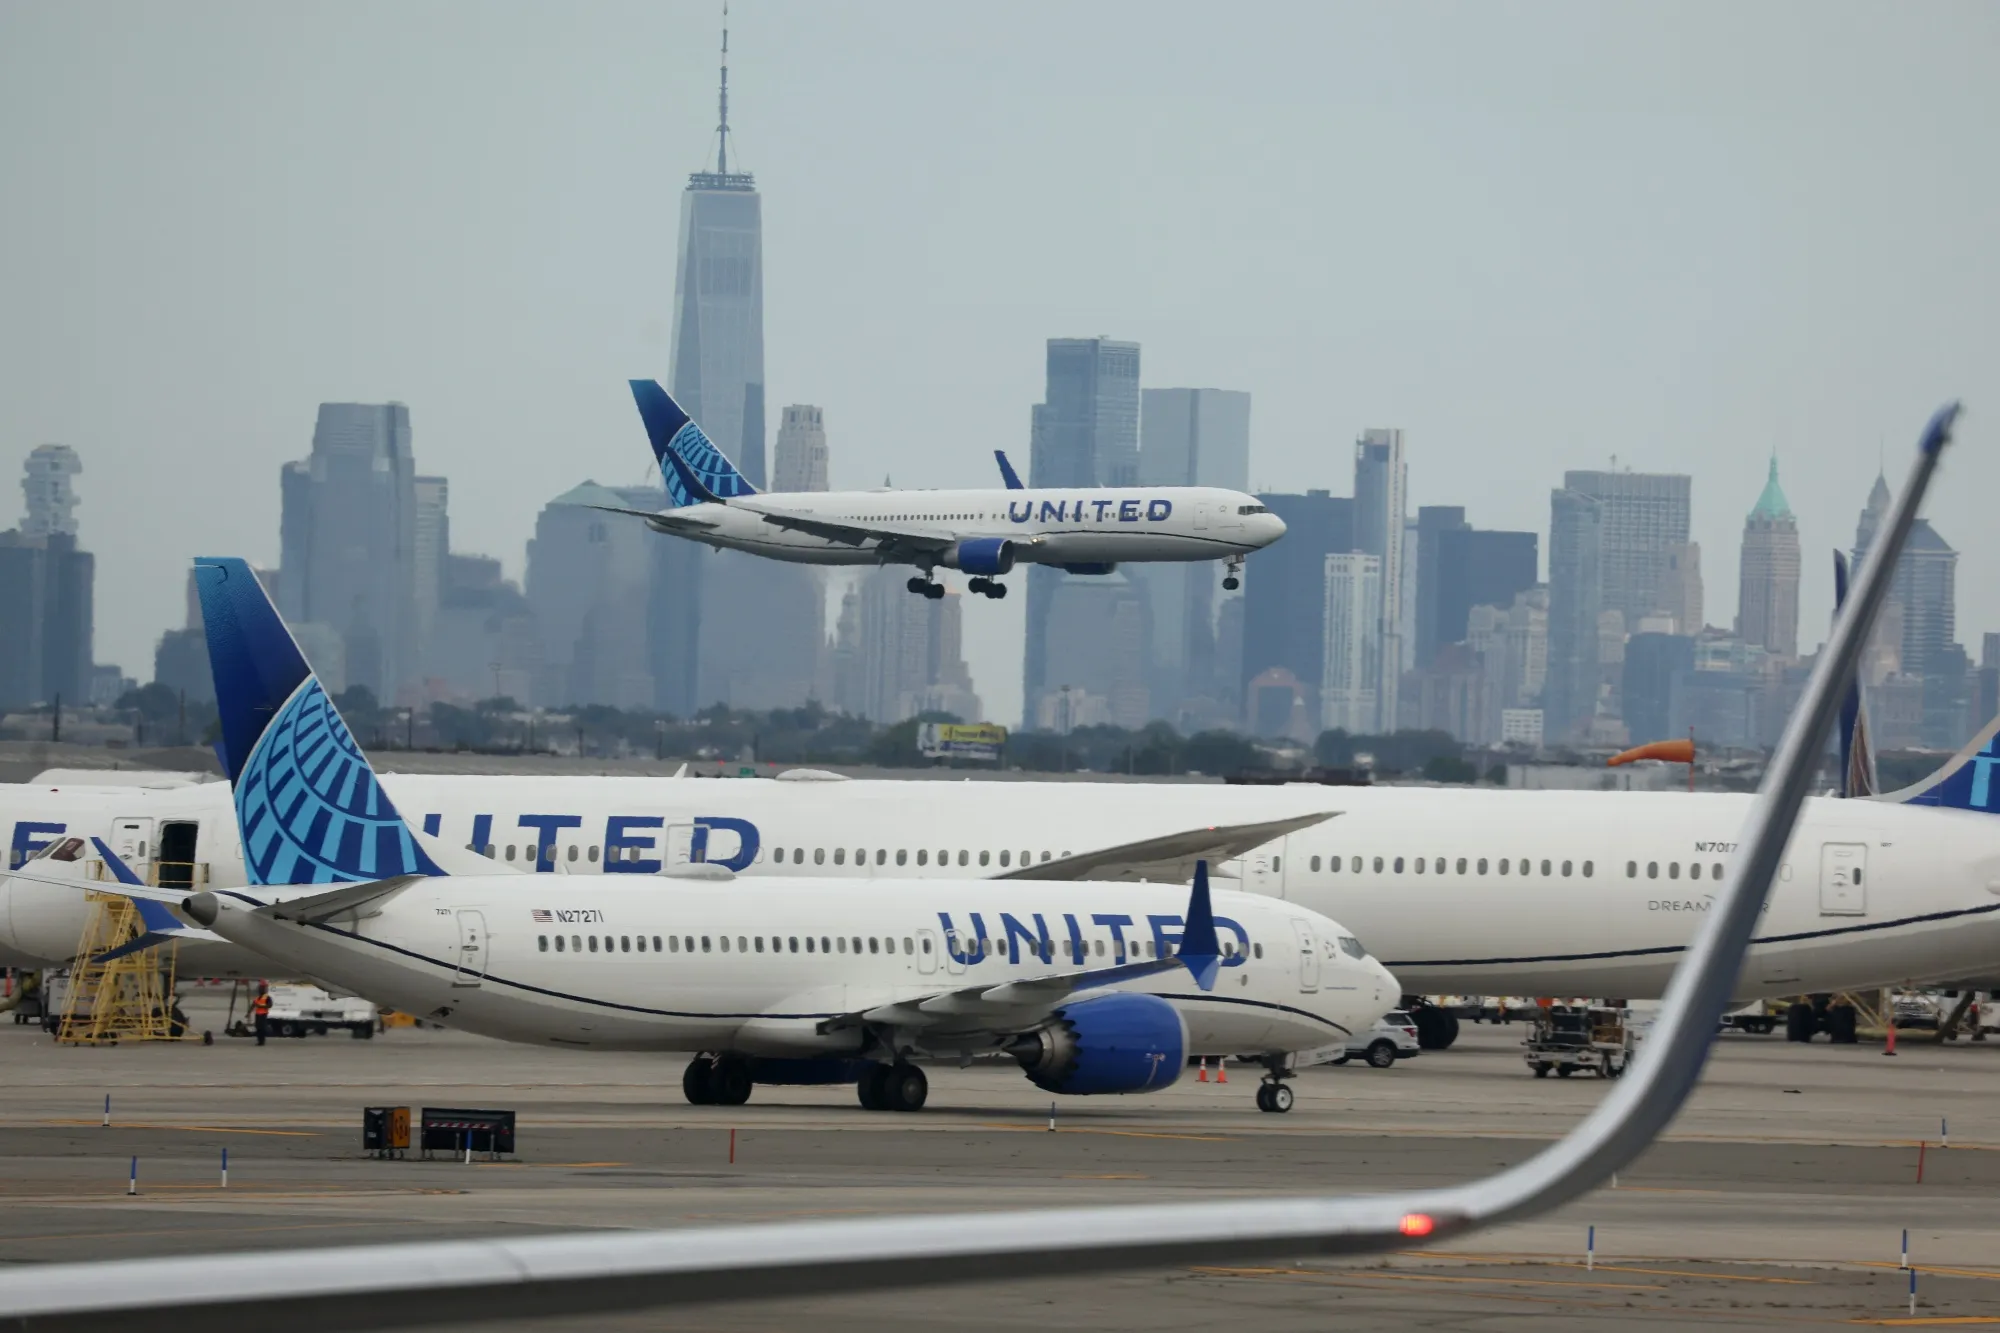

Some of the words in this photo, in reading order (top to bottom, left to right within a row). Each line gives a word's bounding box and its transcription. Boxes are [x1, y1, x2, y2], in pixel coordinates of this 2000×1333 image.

[1009, 500, 1173, 523] UNITED
[556, 909, 604, 923] N27271
[937, 912, 1250, 967] UNITED
